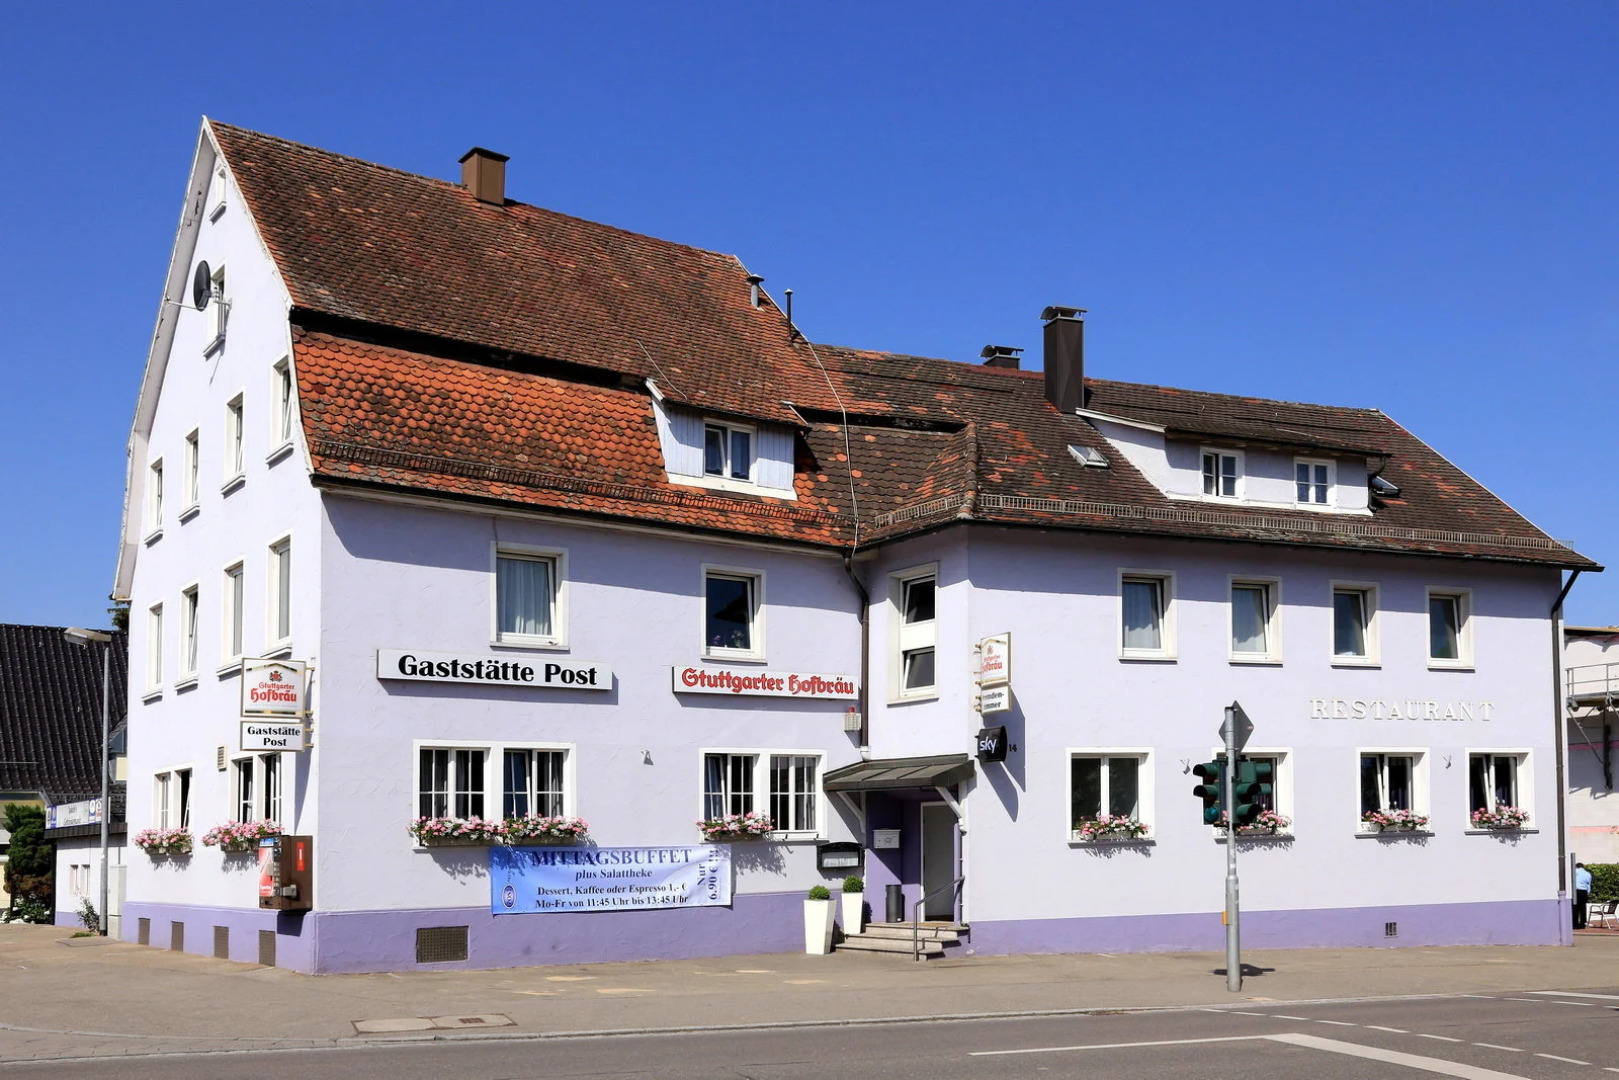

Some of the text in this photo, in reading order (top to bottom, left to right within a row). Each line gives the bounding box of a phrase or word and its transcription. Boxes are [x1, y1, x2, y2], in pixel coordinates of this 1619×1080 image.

[398, 654, 598, 686] Gaststätte Post
[258, 682, 295, 690] Stuttgarter
[681, 667, 855, 695] Stuttgarter Hofbräu
[250, 688, 297, 703] Hofbräu
[1310, 699, 1495, 722] RESTAURANT
[247, 726, 300, 736] Gaststätte
[263, 737, 287, 746] Post
[979, 736, 997, 753] sky
[531, 850, 692, 866] MITTAGSBUFFET
[575, 868, 653, 882] plus Salattheke
[697, 863, 706, 886] Nur
[537, 885, 573, 896] Dessert,
[575, 884, 604, 895] Kaffee
[606, 884, 626, 894] oder
[629, 883, 667, 895] Espresso
[681, 882, 687, 891] €
[535, 895, 689, 909] Mo-Fr von 11:45 Uhr bis 13:45 Uhr
